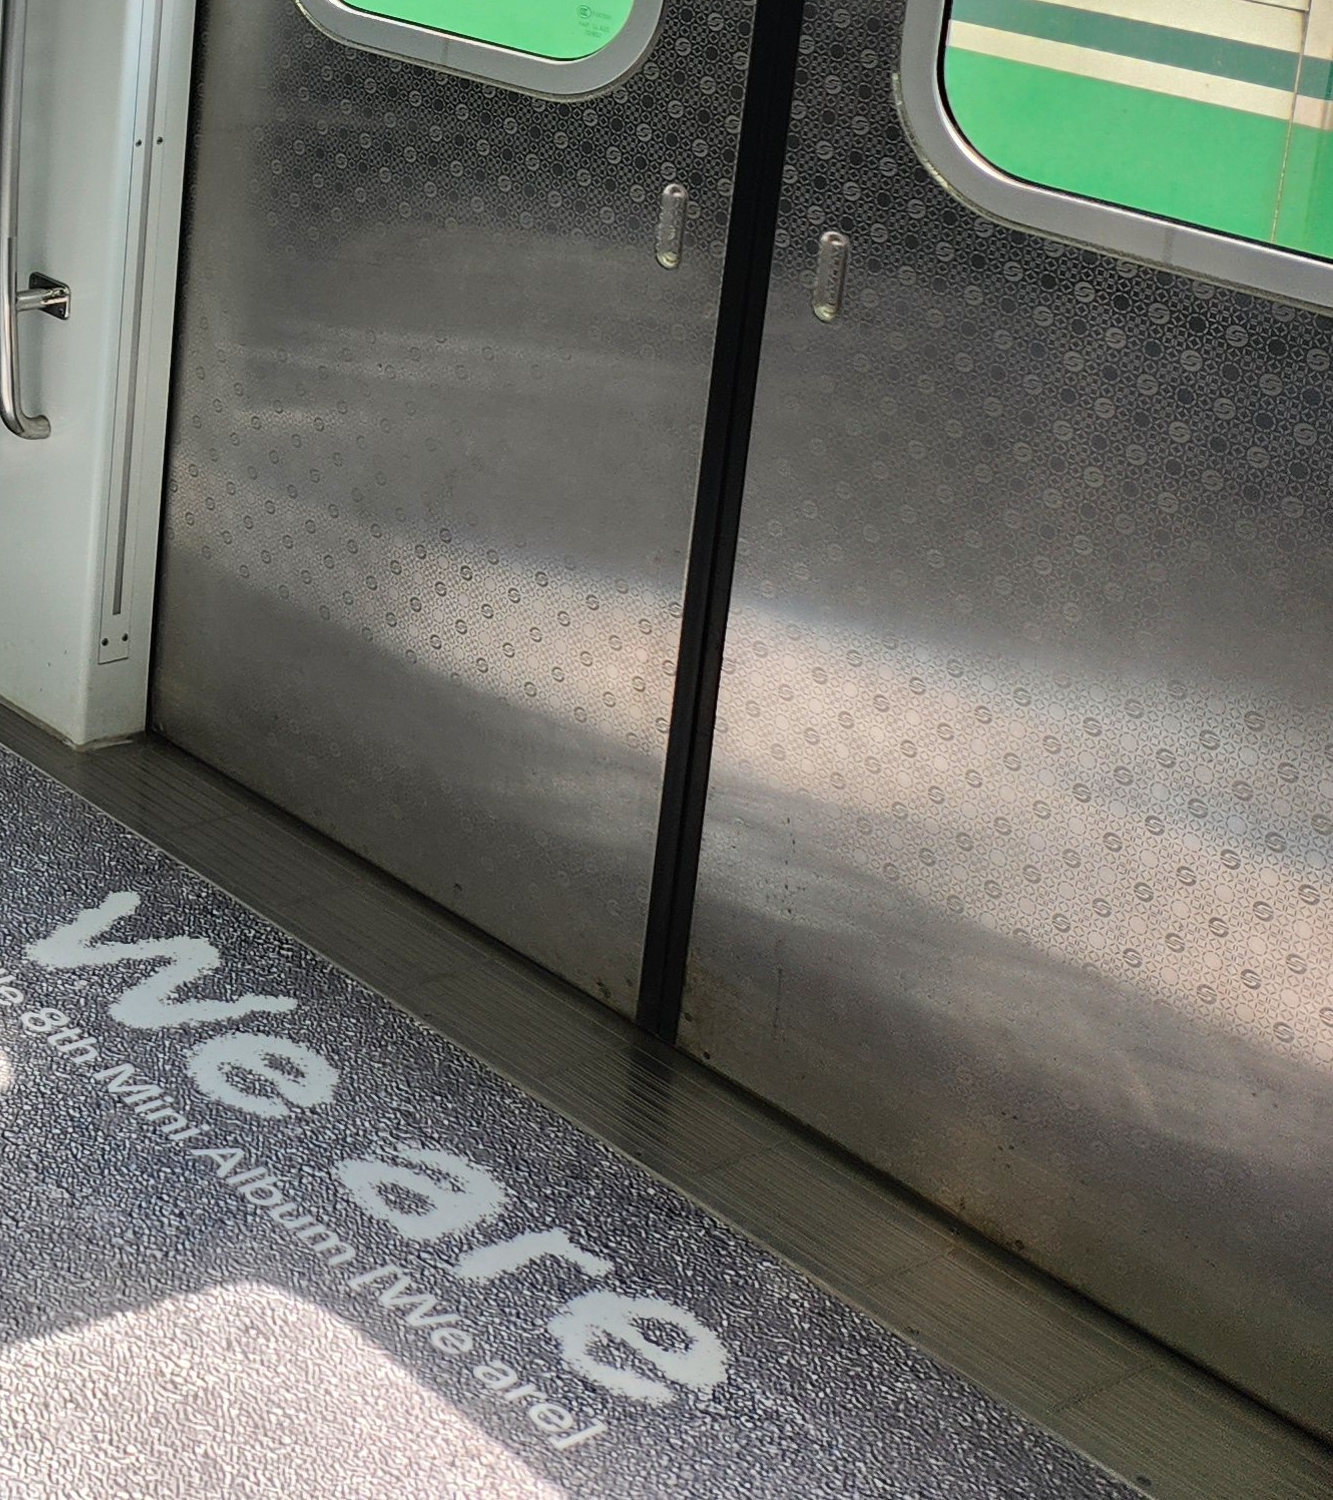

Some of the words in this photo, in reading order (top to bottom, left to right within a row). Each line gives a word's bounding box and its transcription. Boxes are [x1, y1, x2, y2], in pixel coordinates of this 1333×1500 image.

[20, 1006, 99, 1064] 8th
[93, 1062, 212, 1141] Mini
[189, 1146, 356, 1266] Album
[347, 1263, 474, 1355] [We
[472, 1358, 608, 1451] are]
[23, 890, 339, 1118] We
[334, 1140, 733, 1407] are
